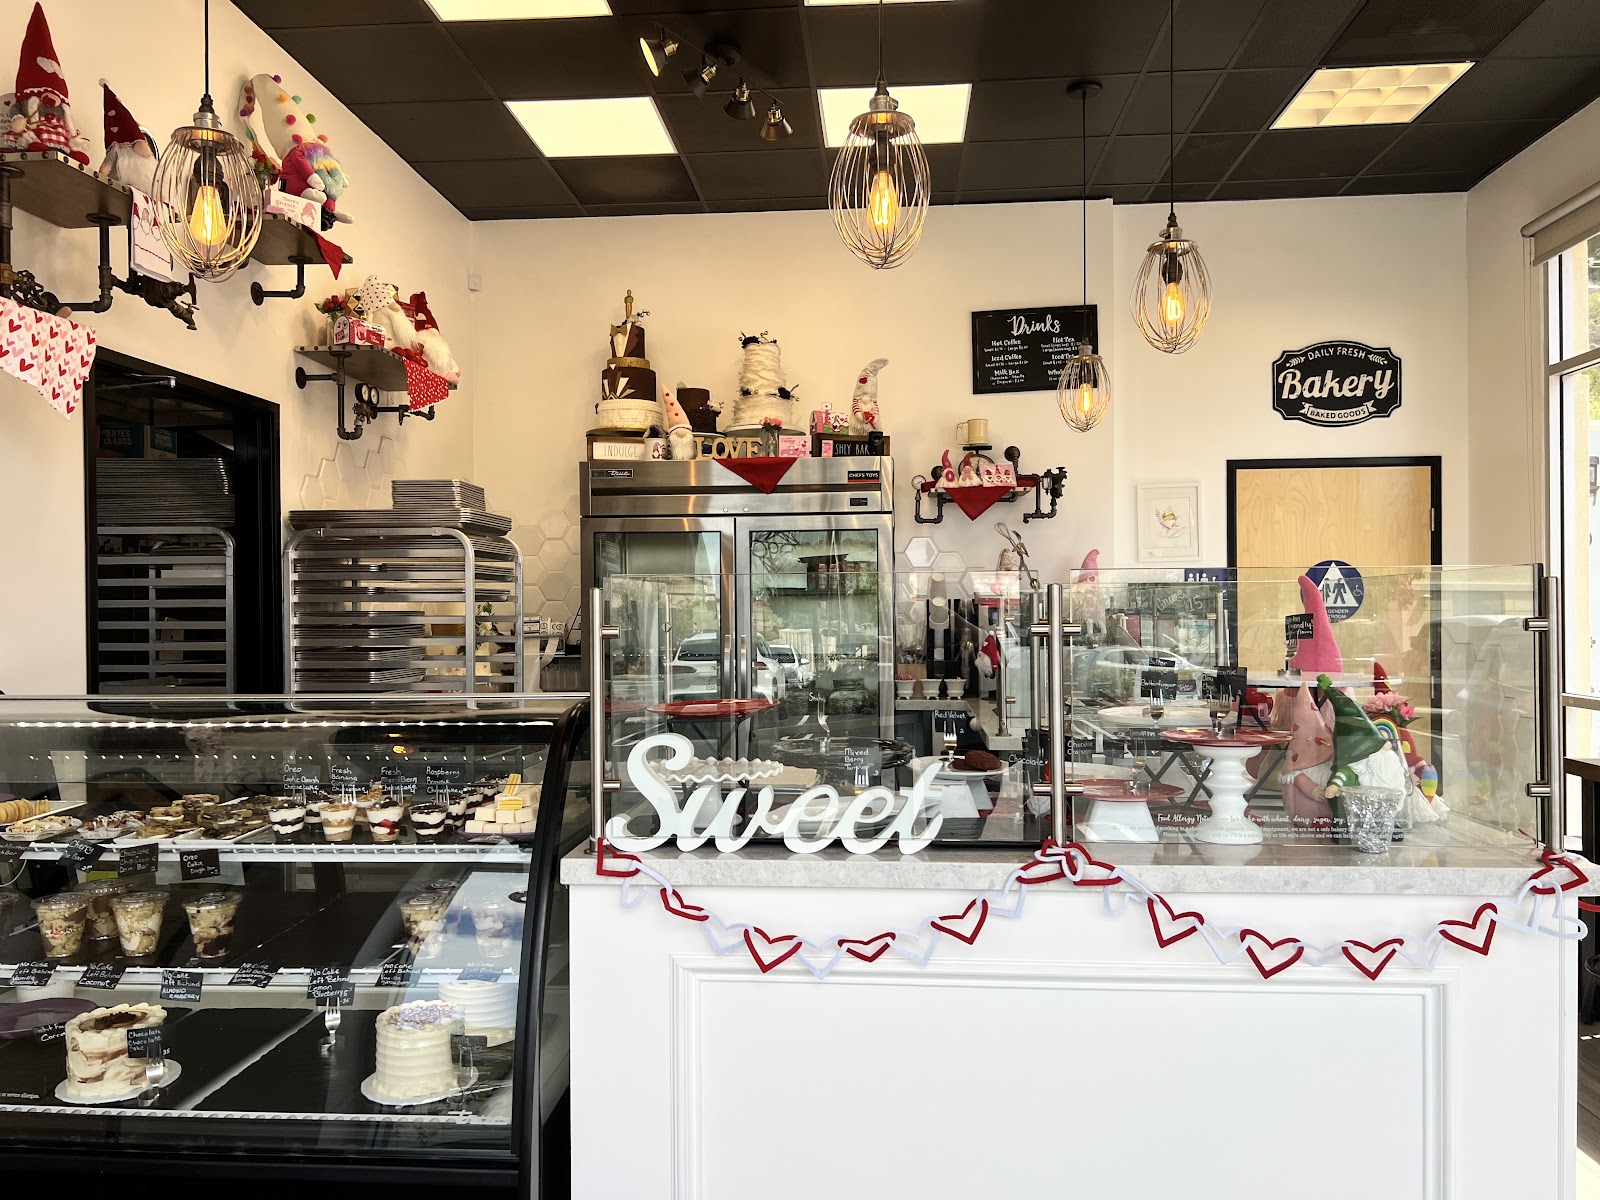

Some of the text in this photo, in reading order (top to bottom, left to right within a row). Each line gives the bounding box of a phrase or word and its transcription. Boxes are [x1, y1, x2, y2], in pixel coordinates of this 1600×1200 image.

[1007, 314, 1061, 336] Drinks
[1307, 347, 1366, 361] DAILY FRESH
[1277, 368, 1395, 399] Bakery
[1309, 407, 1366, 419] BAKED GOODS
[604, 444, 638, 457] INDULGE
[694, 437, 763, 460] LOVE
[1156, 589, 1185, 611] Gnome
[934, 709, 947, 719] Red
[844, 748, 869, 756] Mixed
[844, 756, 864, 764] Berry
[284, 764, 302, 773] Oreo
[331, 765, 352, 775] Fresh
[381, 766, 401, 776] Fresh
[426, 766, 460, 778] Raspberry
[605, 732, 943, 855] Sweet
[1157, 814, 1170, 822] Food
[1172, 814, 1195, 824] Allergy
[79, 978, 110, 987] Coconut
[325, 975, 351, 983] Behind
[128, 1029, 161, 1039] Chocolate
[128, 1036, 161, 1046] Chocolate
